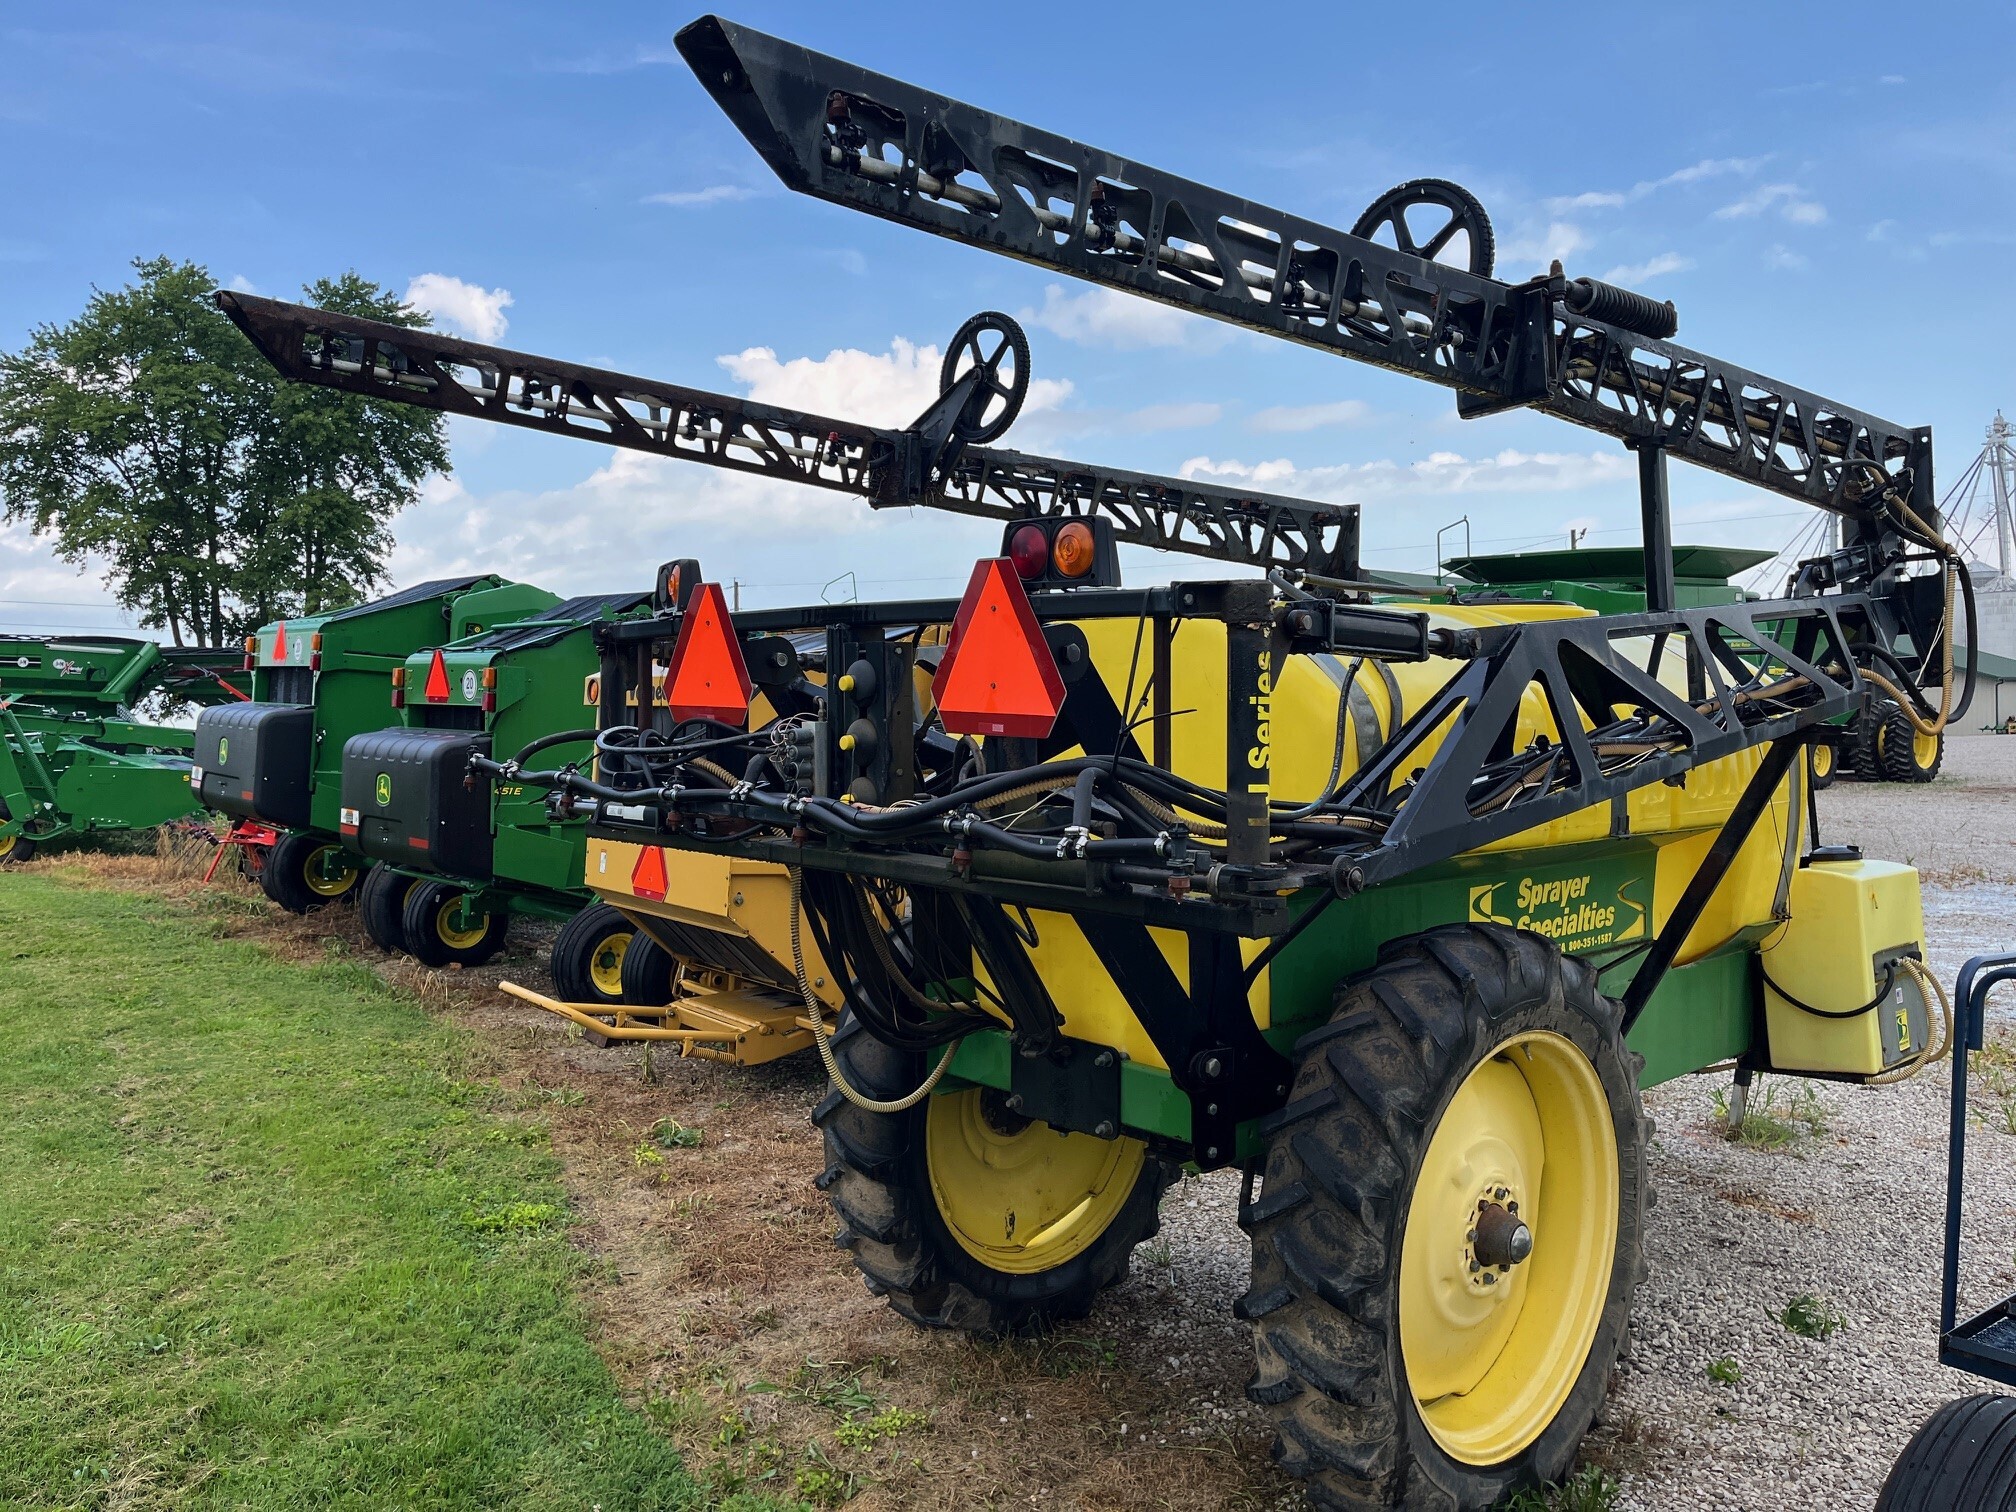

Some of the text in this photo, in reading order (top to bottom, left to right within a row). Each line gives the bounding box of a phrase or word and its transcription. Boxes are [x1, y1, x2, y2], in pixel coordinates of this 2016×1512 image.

[466, 677, 474, 690] 20
[1247, 650, 1270, 770] Series
[1517, 876, 1590, 914] Sprayer
[1568, 932, 1613, 952] 800-351-1587
